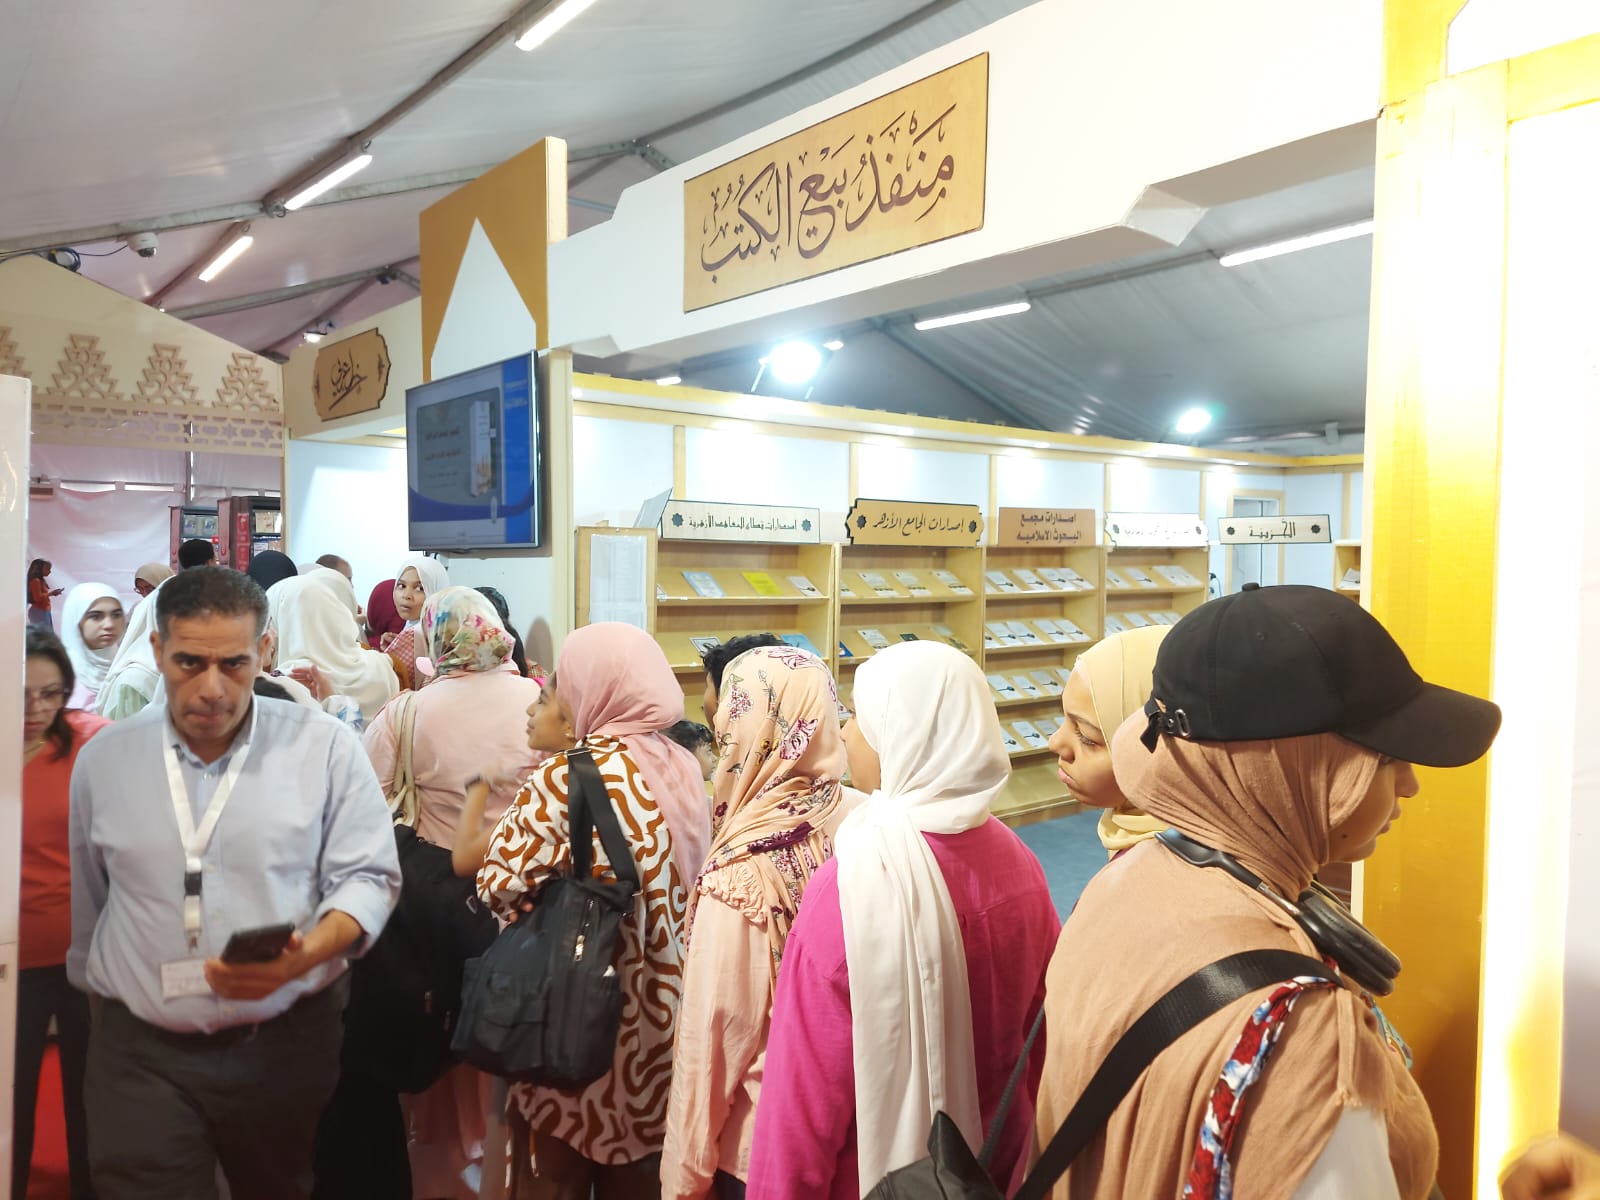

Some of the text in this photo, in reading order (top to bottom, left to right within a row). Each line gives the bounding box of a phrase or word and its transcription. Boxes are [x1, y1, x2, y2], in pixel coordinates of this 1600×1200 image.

[700, 103, 957, 284] منفذ بيع الكتب
[901, 512, 926, 536] الجامع
